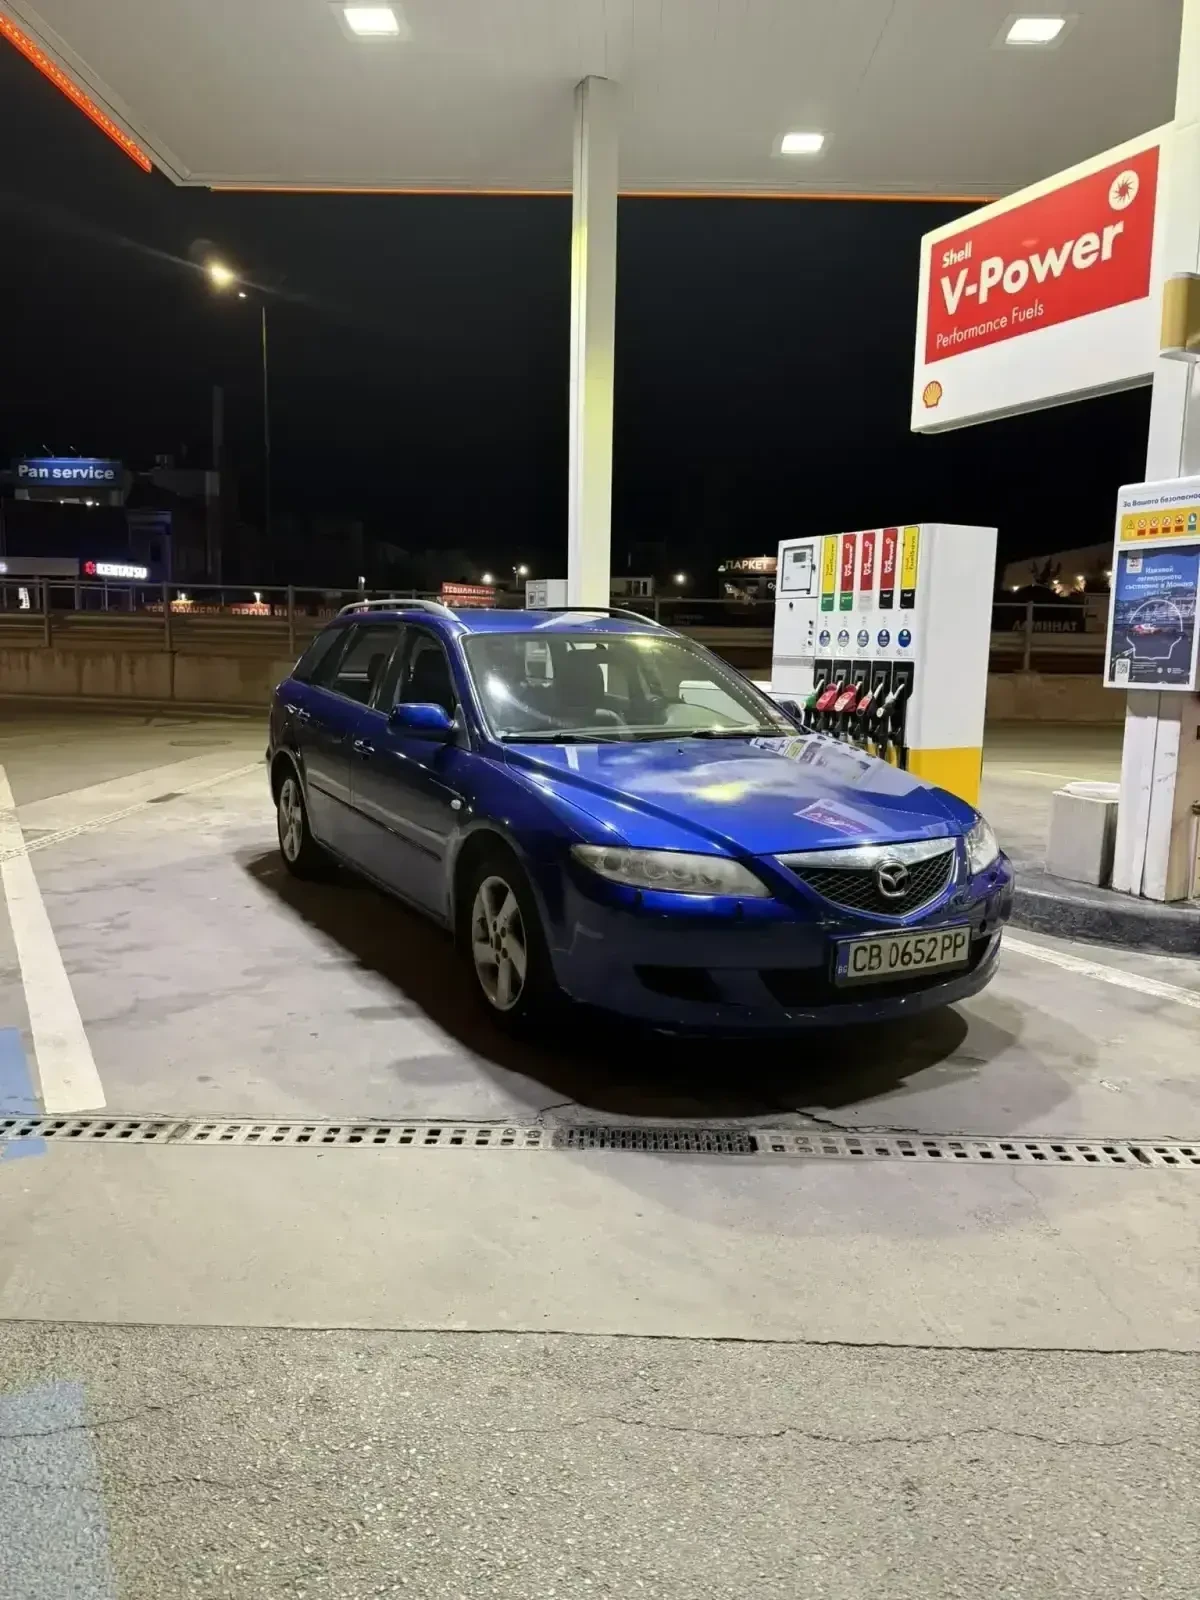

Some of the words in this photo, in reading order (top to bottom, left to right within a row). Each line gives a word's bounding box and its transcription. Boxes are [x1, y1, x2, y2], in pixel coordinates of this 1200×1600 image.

[942, 241, 973, 269] Shell
[940, 220, 1125, 316] V-Power
[936, 315, 1007, 349] Performance
[1011, 299, 1044, 325] Fuels
[18, 464, 48, 478] Pan
[52, 465, 115, 480] service
[1123, 500, 1131, 508] За
[1132, 498, 1159, 507] Вашата
[725, 559, 768, 571] ПАРКЕТ
